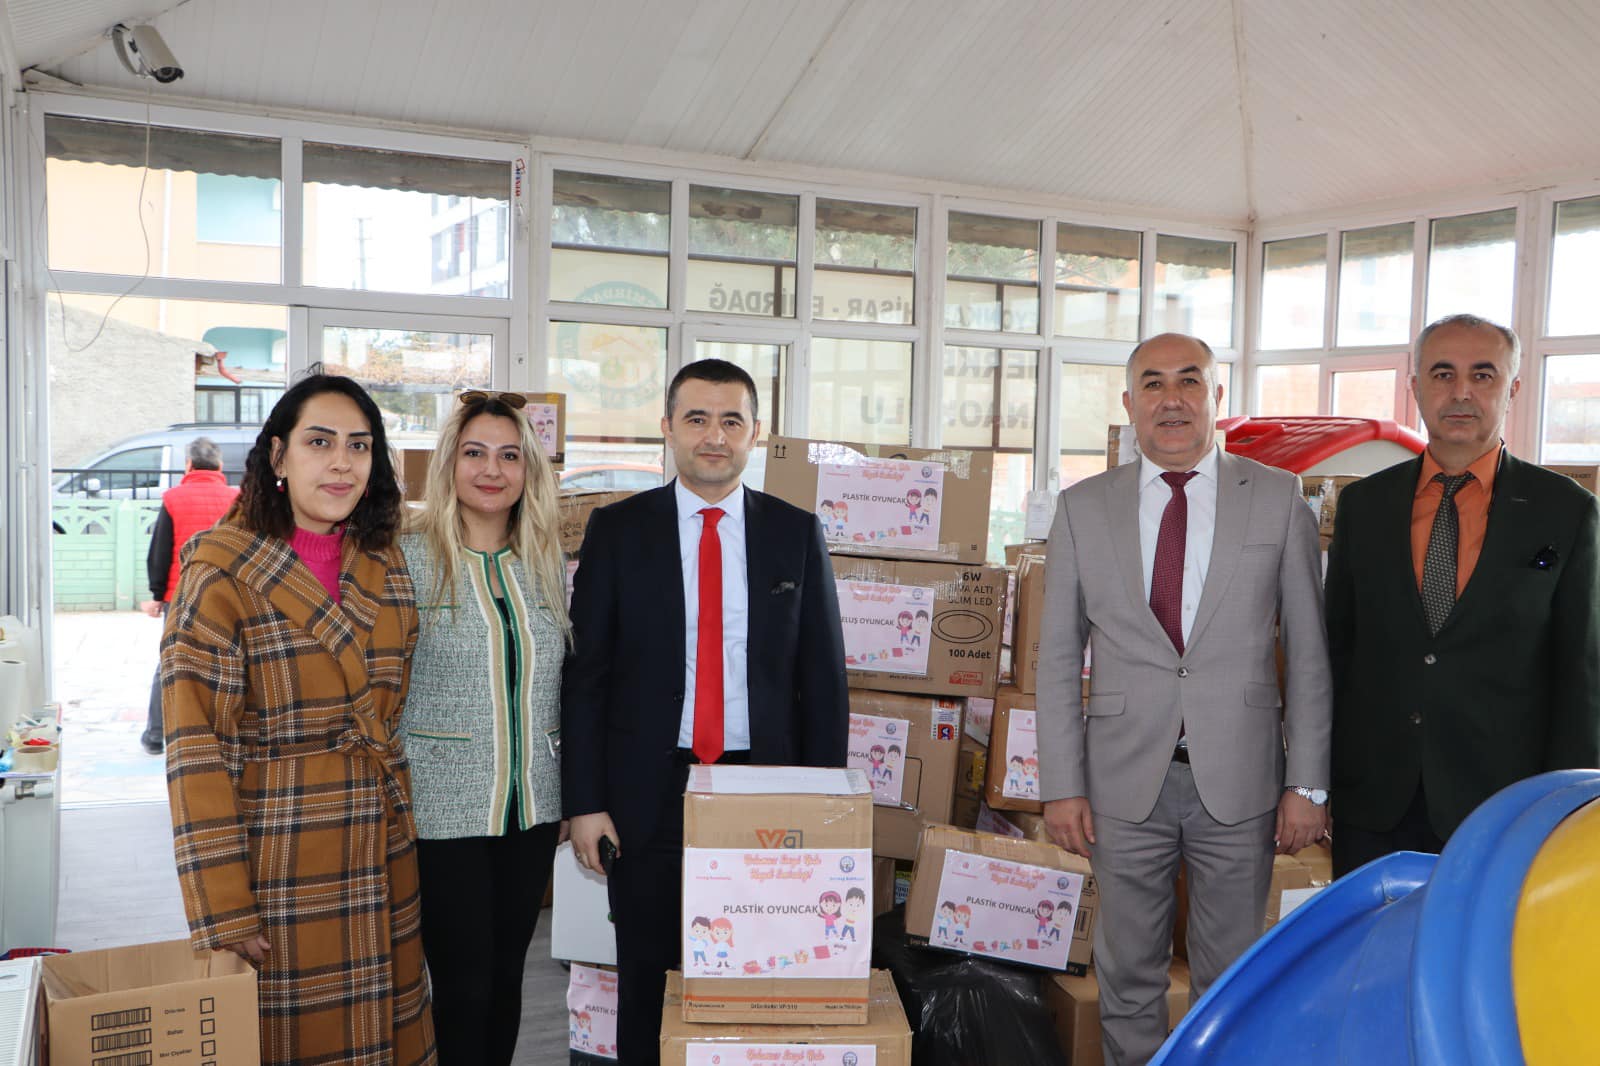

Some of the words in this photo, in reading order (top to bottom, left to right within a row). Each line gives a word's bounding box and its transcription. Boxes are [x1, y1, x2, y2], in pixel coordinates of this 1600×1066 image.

[872, 494, 906, 505] OYUNCAK
[973, 597, 993, 607] LED
[859, 617, 895, 628] OYUNCAK
[949, 649, 966, 659] 100
[967, 649, 992, 660] Adet
[847, 750, 870, 760] NCAK
[723, 903, 765, 914] PLASTİK
[766, 904, 819, 914] OYUNCAK
[966, 895, 997, 909] PLASTİK
[998, 901, 1036, 915] OYUNCAK
